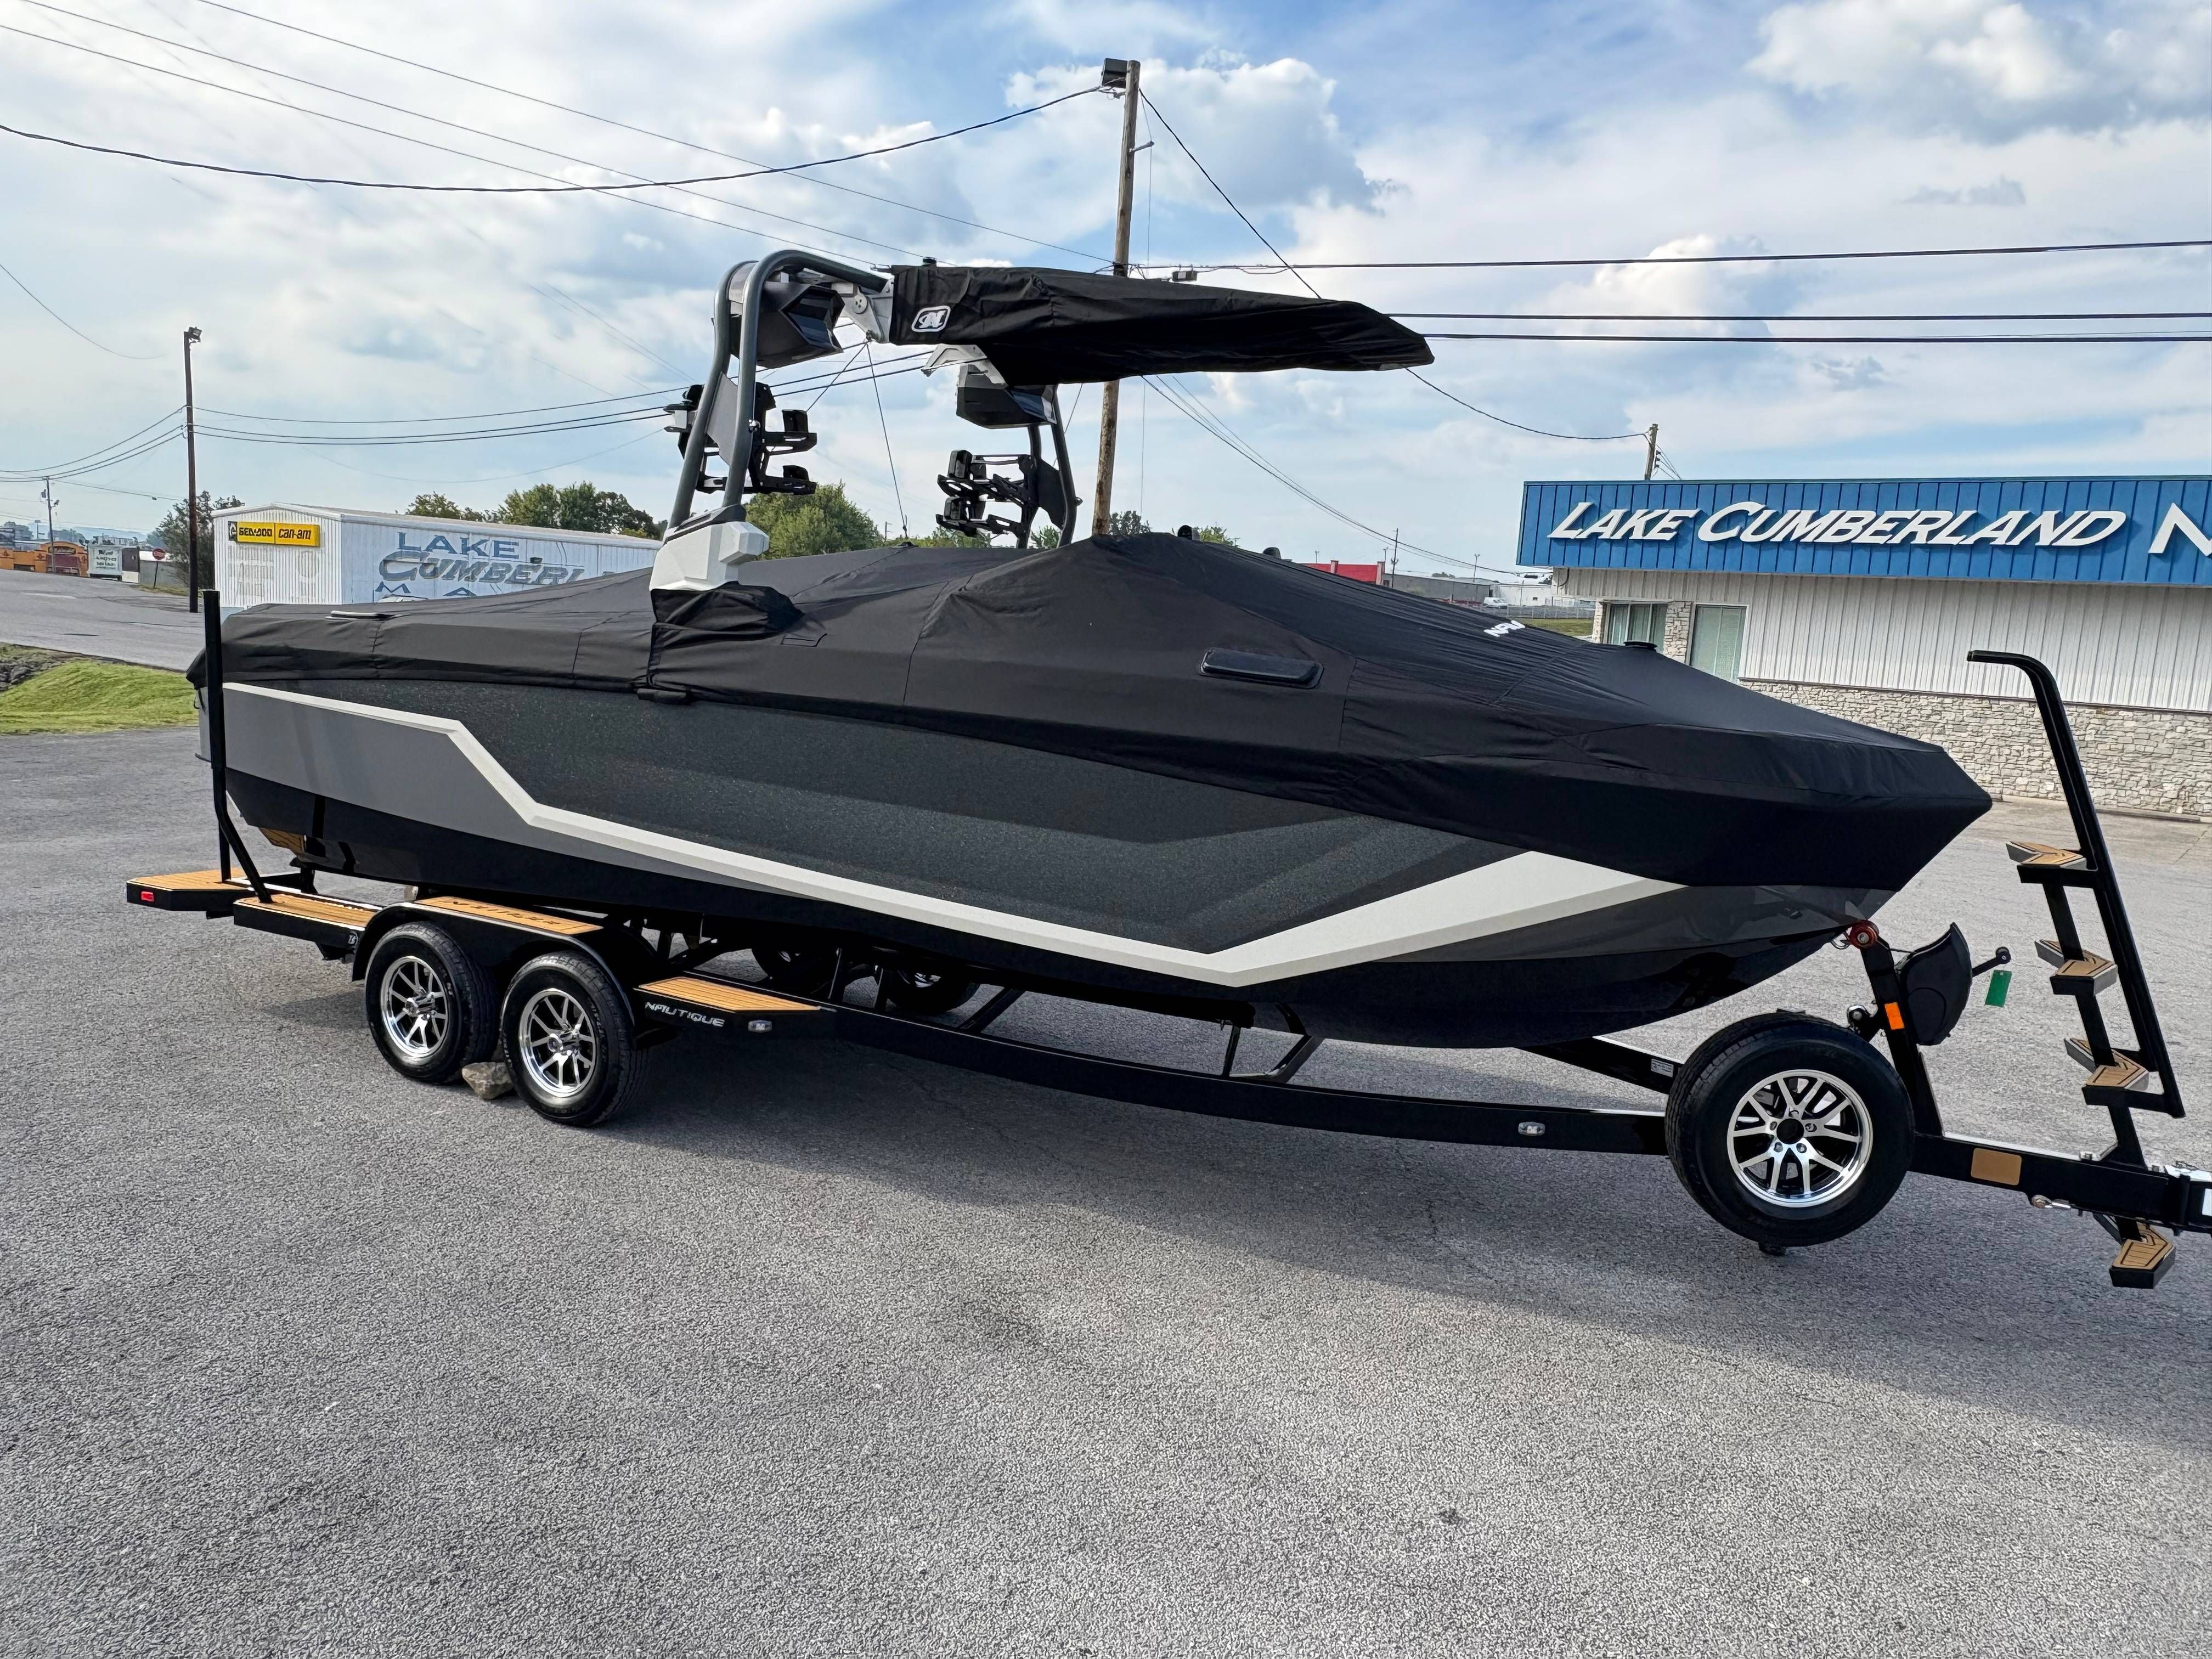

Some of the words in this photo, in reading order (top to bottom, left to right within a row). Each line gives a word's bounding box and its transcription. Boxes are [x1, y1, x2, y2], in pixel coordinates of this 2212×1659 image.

[1547, 501, 1700, 540] LAKE
[1697, 500, 2126, 546] CUMBERLAND
[397, 531, 520, 560] LAKE
[645, 1001, 725, 1028] NAUTIQUE
